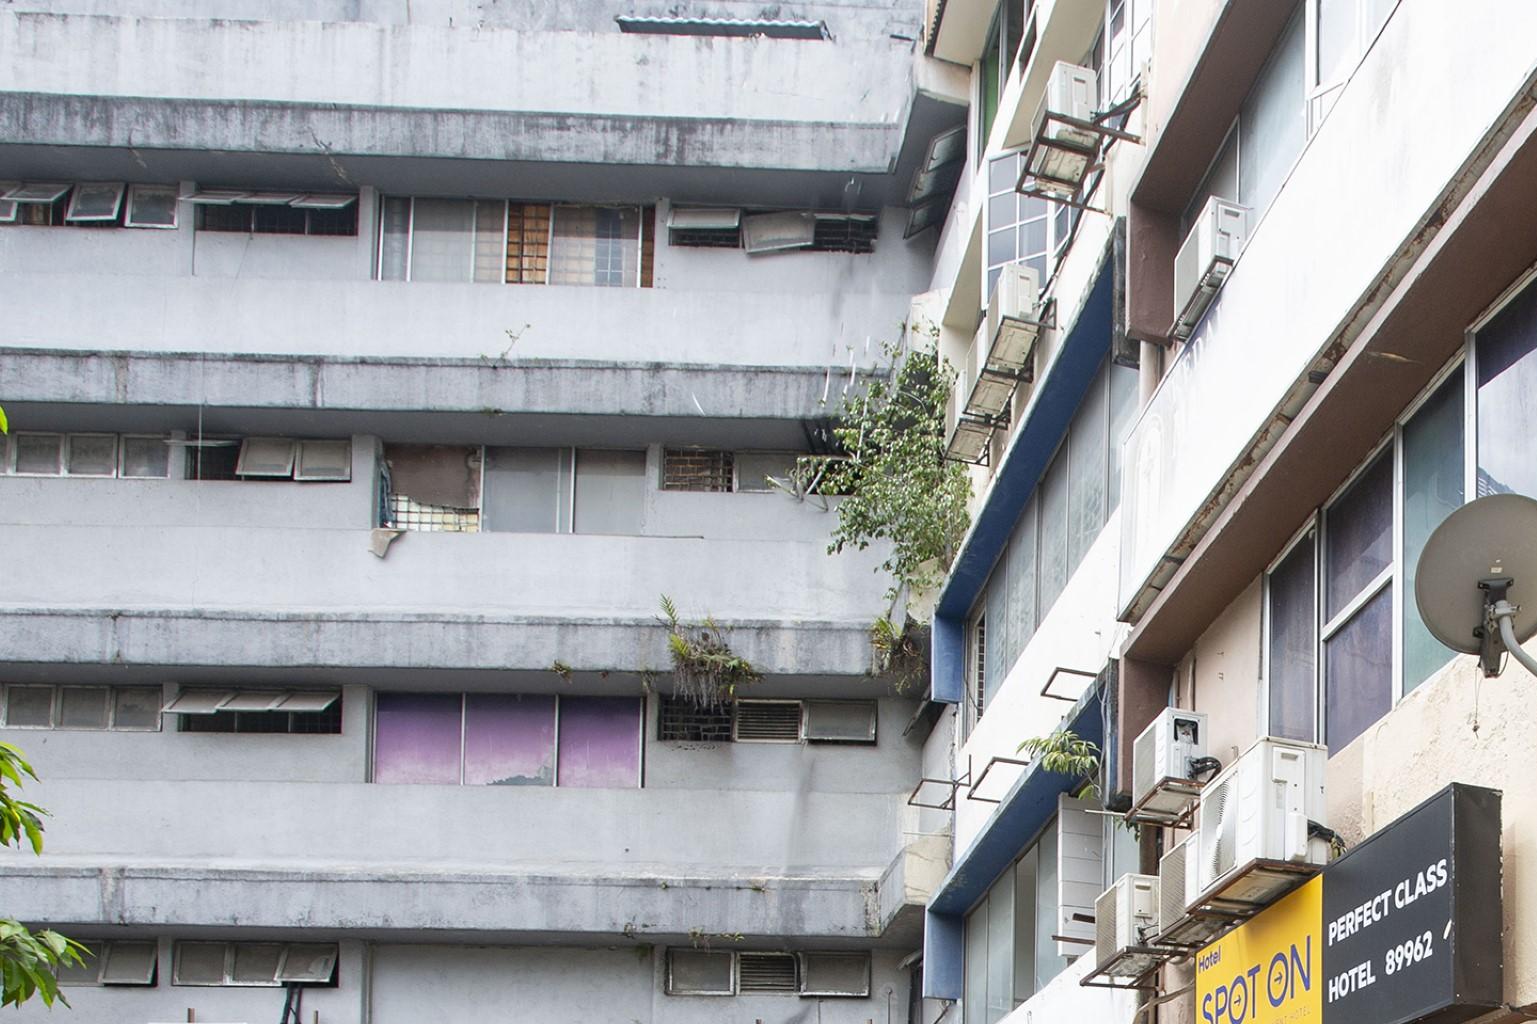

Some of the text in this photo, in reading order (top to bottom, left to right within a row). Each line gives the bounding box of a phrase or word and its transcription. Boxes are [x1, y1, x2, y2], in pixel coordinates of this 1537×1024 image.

[1328, 858, 1448, 947] PERFECT CLASS
[1198, 944, 1222, 974] Hotel
[1268, 935, 1311, 1008] ON
[1328, 930, 1433, 1003] HOTEL 89962
